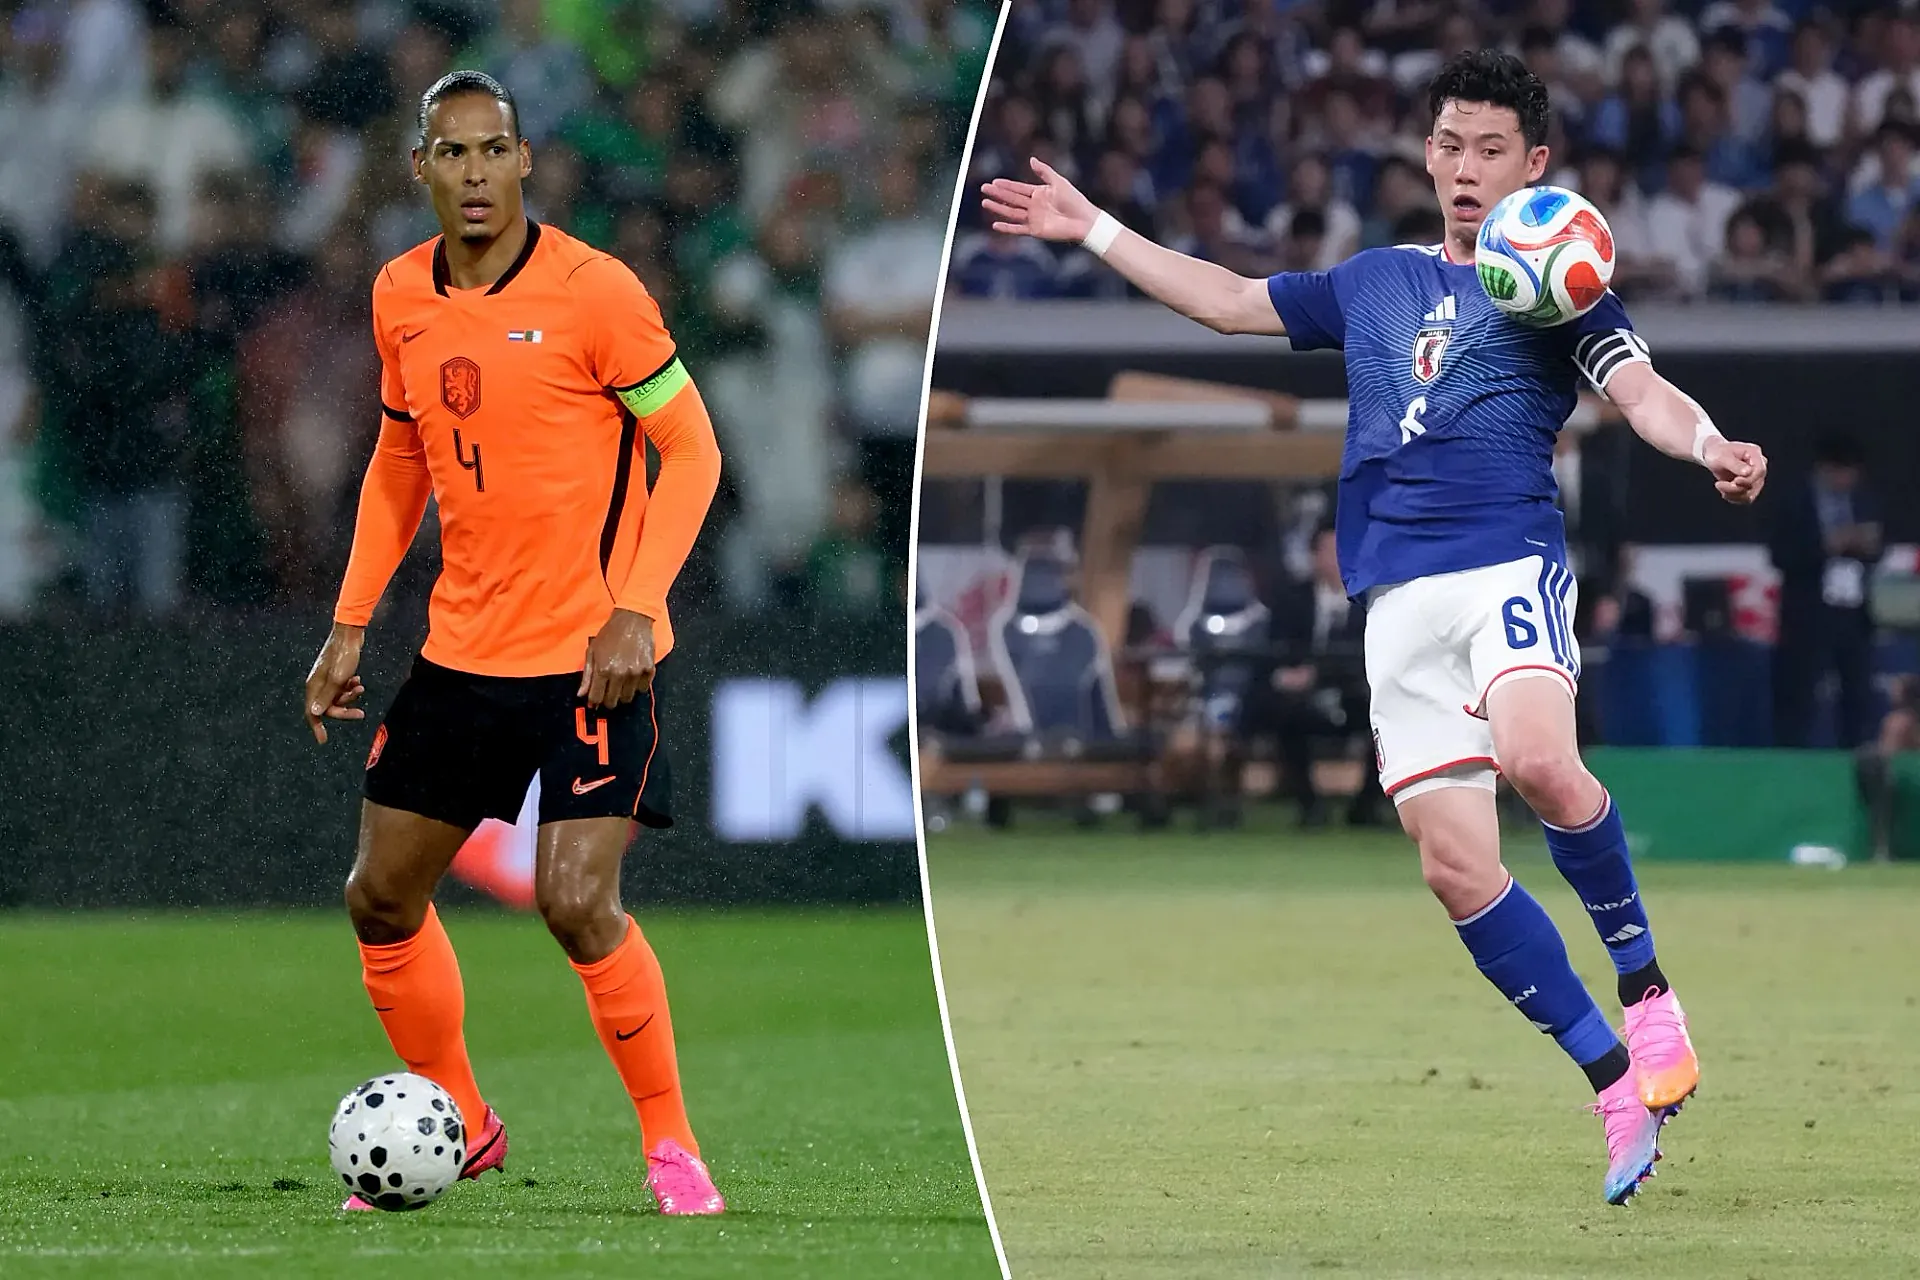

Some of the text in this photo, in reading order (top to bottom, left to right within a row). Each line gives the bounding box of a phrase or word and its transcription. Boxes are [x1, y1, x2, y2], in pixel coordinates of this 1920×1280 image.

[634, 365, 675, 398] RESPEC
[452, 428, 485, 492] 4
[1501, 596, 1539, 650] 6
[575, 706, 609, 765] 4
